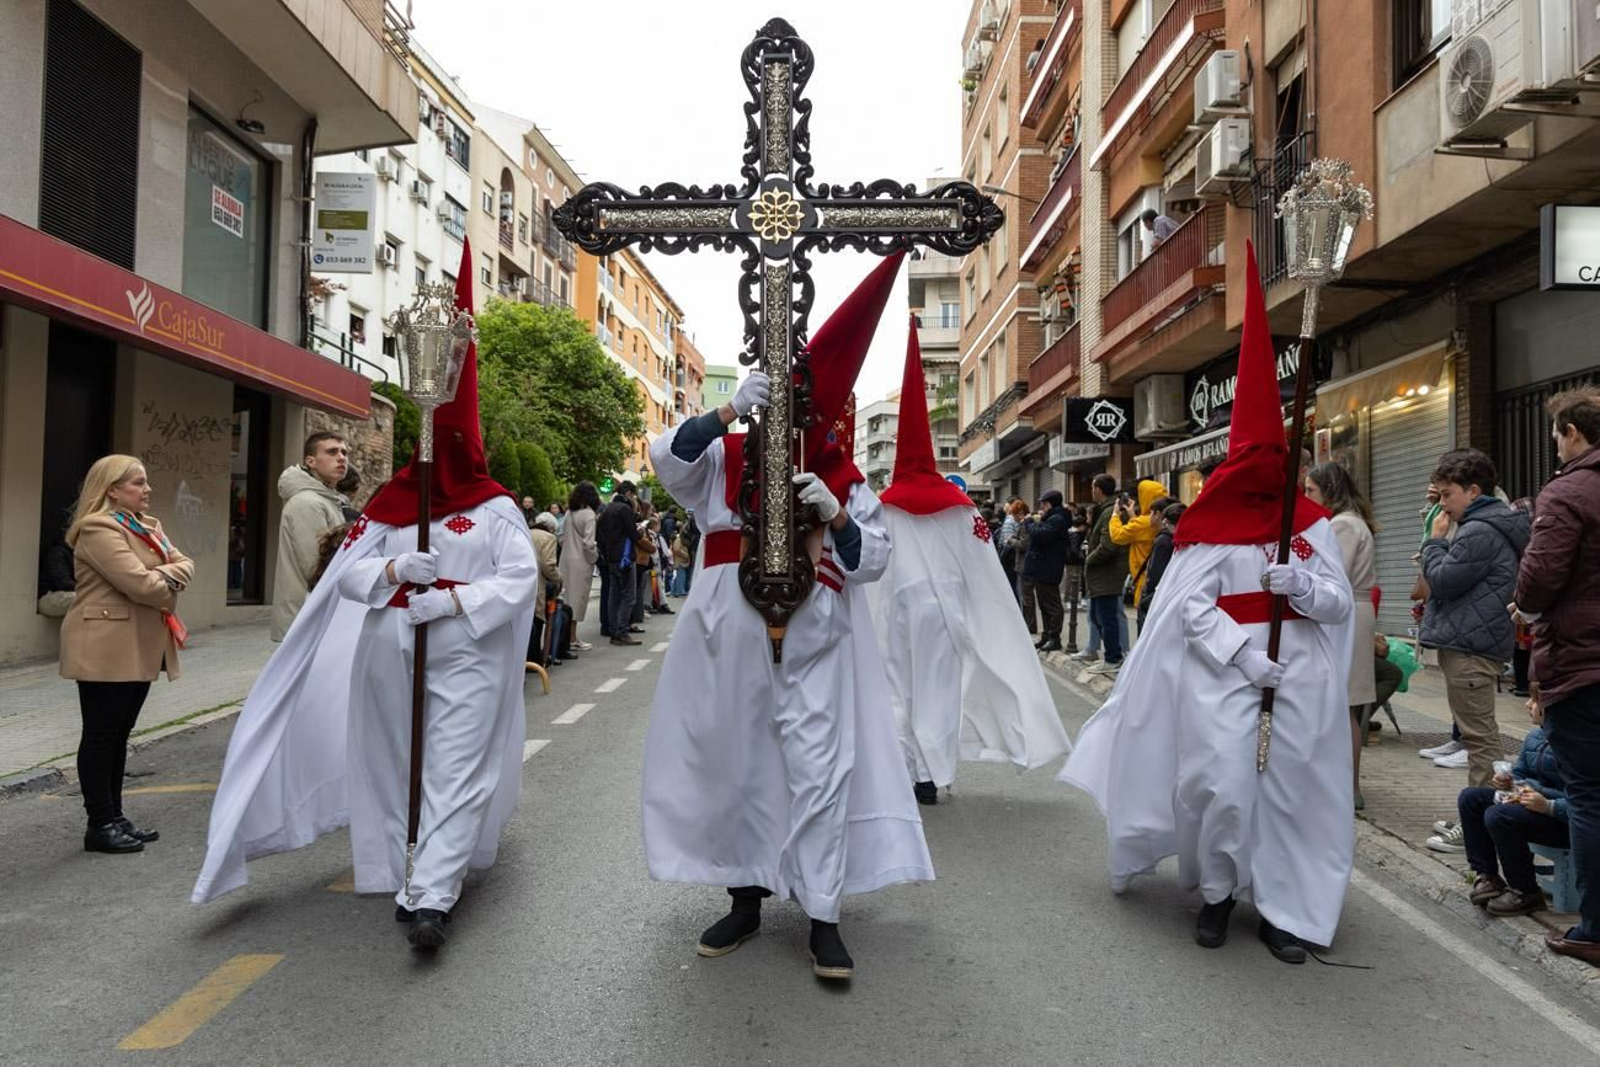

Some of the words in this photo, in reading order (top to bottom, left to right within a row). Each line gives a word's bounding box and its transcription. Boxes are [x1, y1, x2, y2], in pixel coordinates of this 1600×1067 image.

[189, 146, 235, 192] LUQUE
[221, 192, 242, 217] ALQUILA
[158, 300, 225, 350] CajaSur
[1178, 445, 1201, 467] RAMOS
